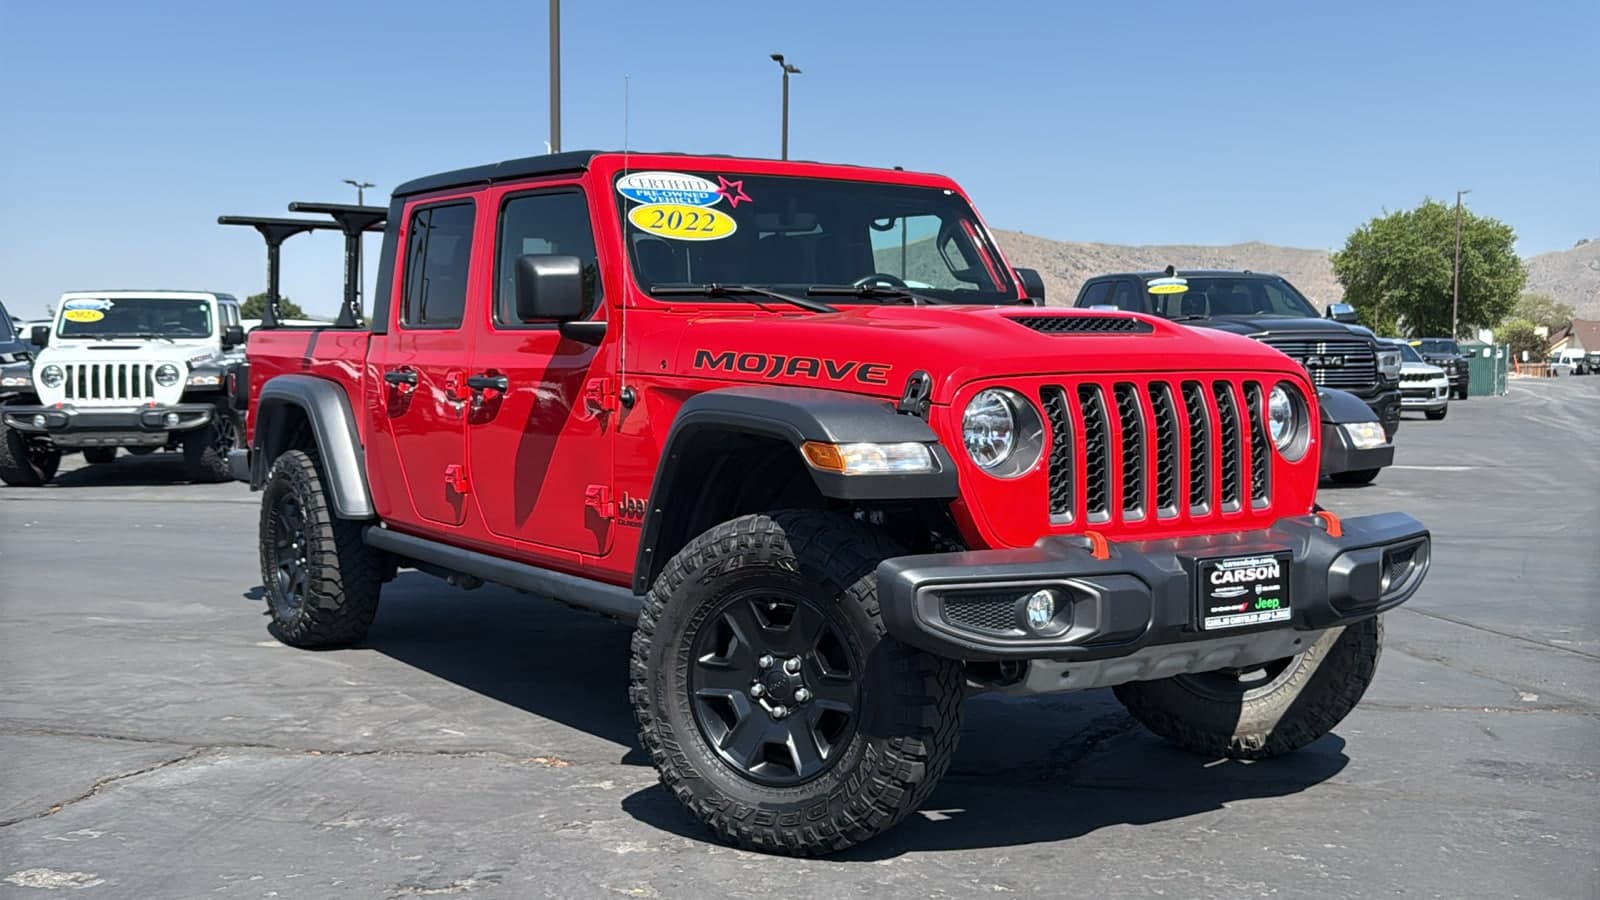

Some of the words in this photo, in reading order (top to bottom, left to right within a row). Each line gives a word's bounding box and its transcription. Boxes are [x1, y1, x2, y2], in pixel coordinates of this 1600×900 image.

[628, 177, 709, 190] CERTIFIED
[635, 190, 710, 198] PRE-OWNED
[650, 196, 701, 204] VEHICLE
[650, 209, 716, 232] 2022
[693, 348, 893, 385] MOJAVE
[1210, 565, 1280, 584] CARSON
[1255, 597, 1281, 609] Jeep
